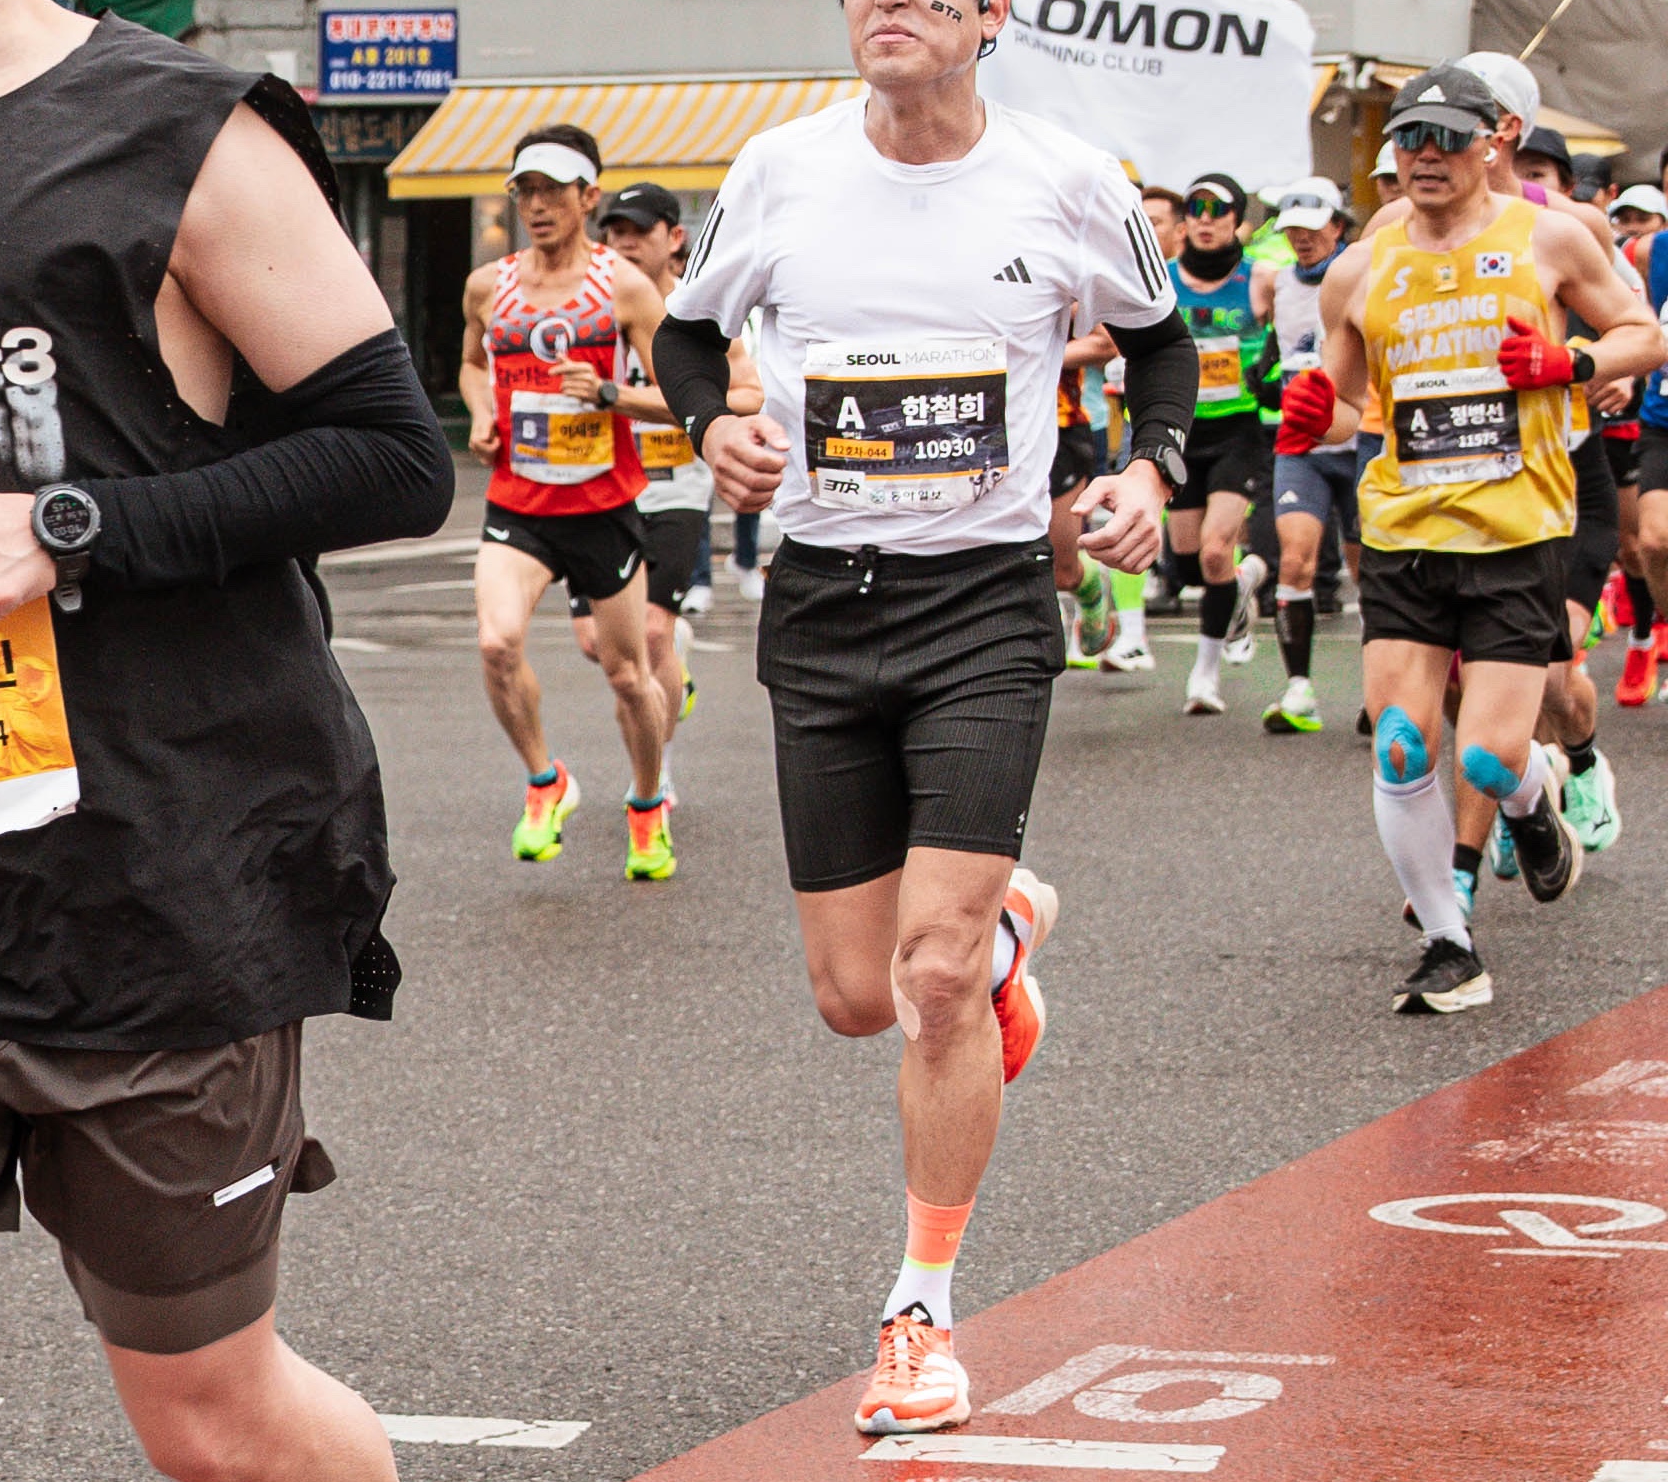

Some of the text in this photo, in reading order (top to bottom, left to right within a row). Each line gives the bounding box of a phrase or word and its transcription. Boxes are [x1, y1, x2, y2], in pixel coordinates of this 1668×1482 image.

[1101, 49, 1164, 77] CLUB
[1398, 292, 1498, 336] SEJONG
[846, 347, 997, 366] SEOUL MARATHON
[836, 391, 985, 430] A 한철희
[1410, 407, 1430, 432] A
[914, 438, 976, 460] 10930
